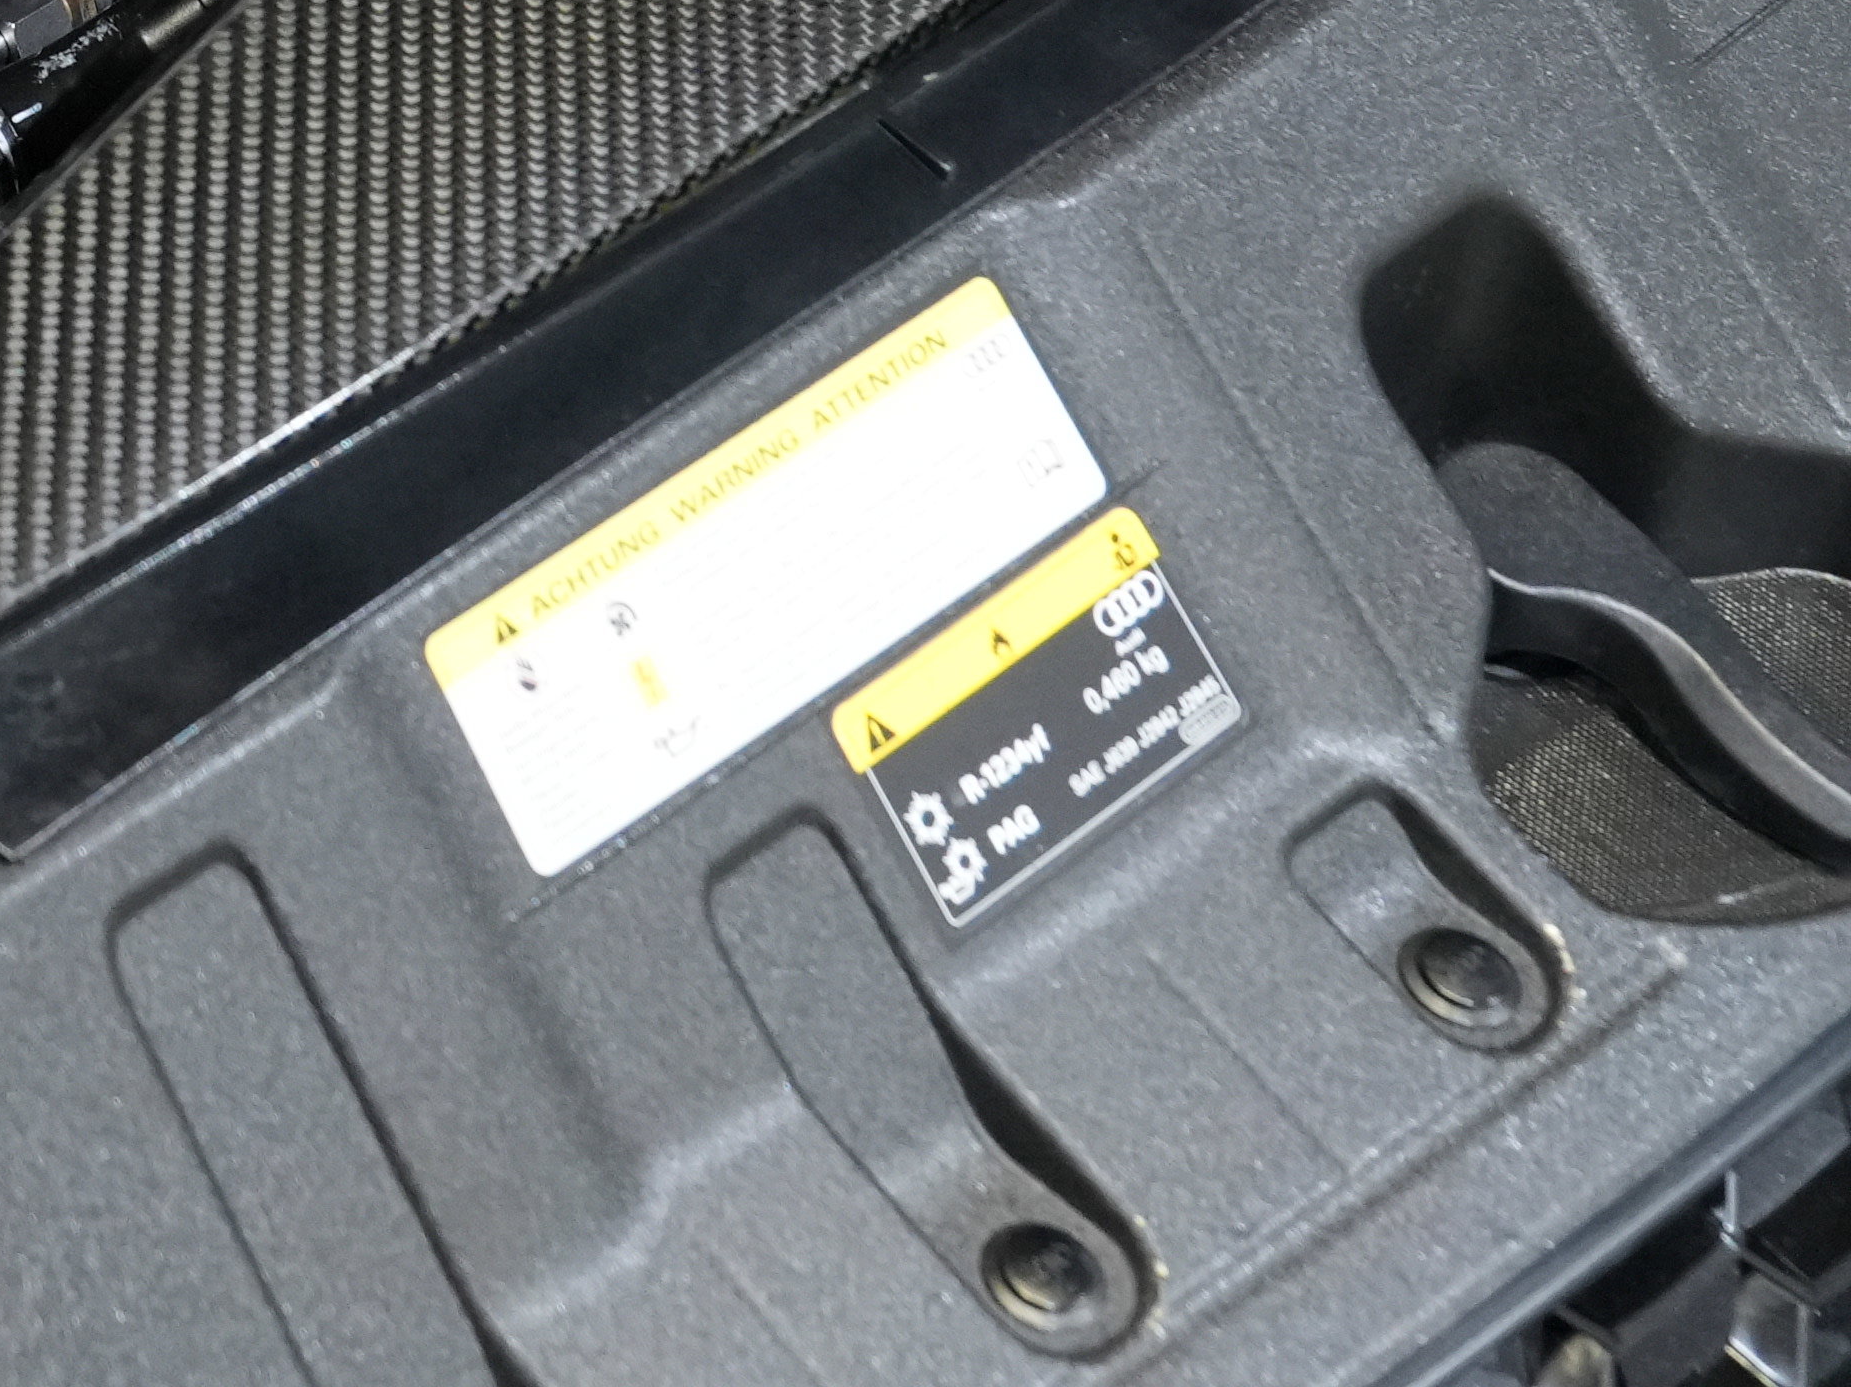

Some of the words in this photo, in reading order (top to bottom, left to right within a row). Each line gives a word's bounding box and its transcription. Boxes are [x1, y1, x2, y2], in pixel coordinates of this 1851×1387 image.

[532, 521, 661, 620] ACHTUNG
[671, 427, 800, 523] WARNING
[810, 329, 949, 430] ATTENTION
[1134, 644, 1167, 676] kg
[1068, 759, 1106, 797] SAE
[986, 805, 1040, 855] PAG
